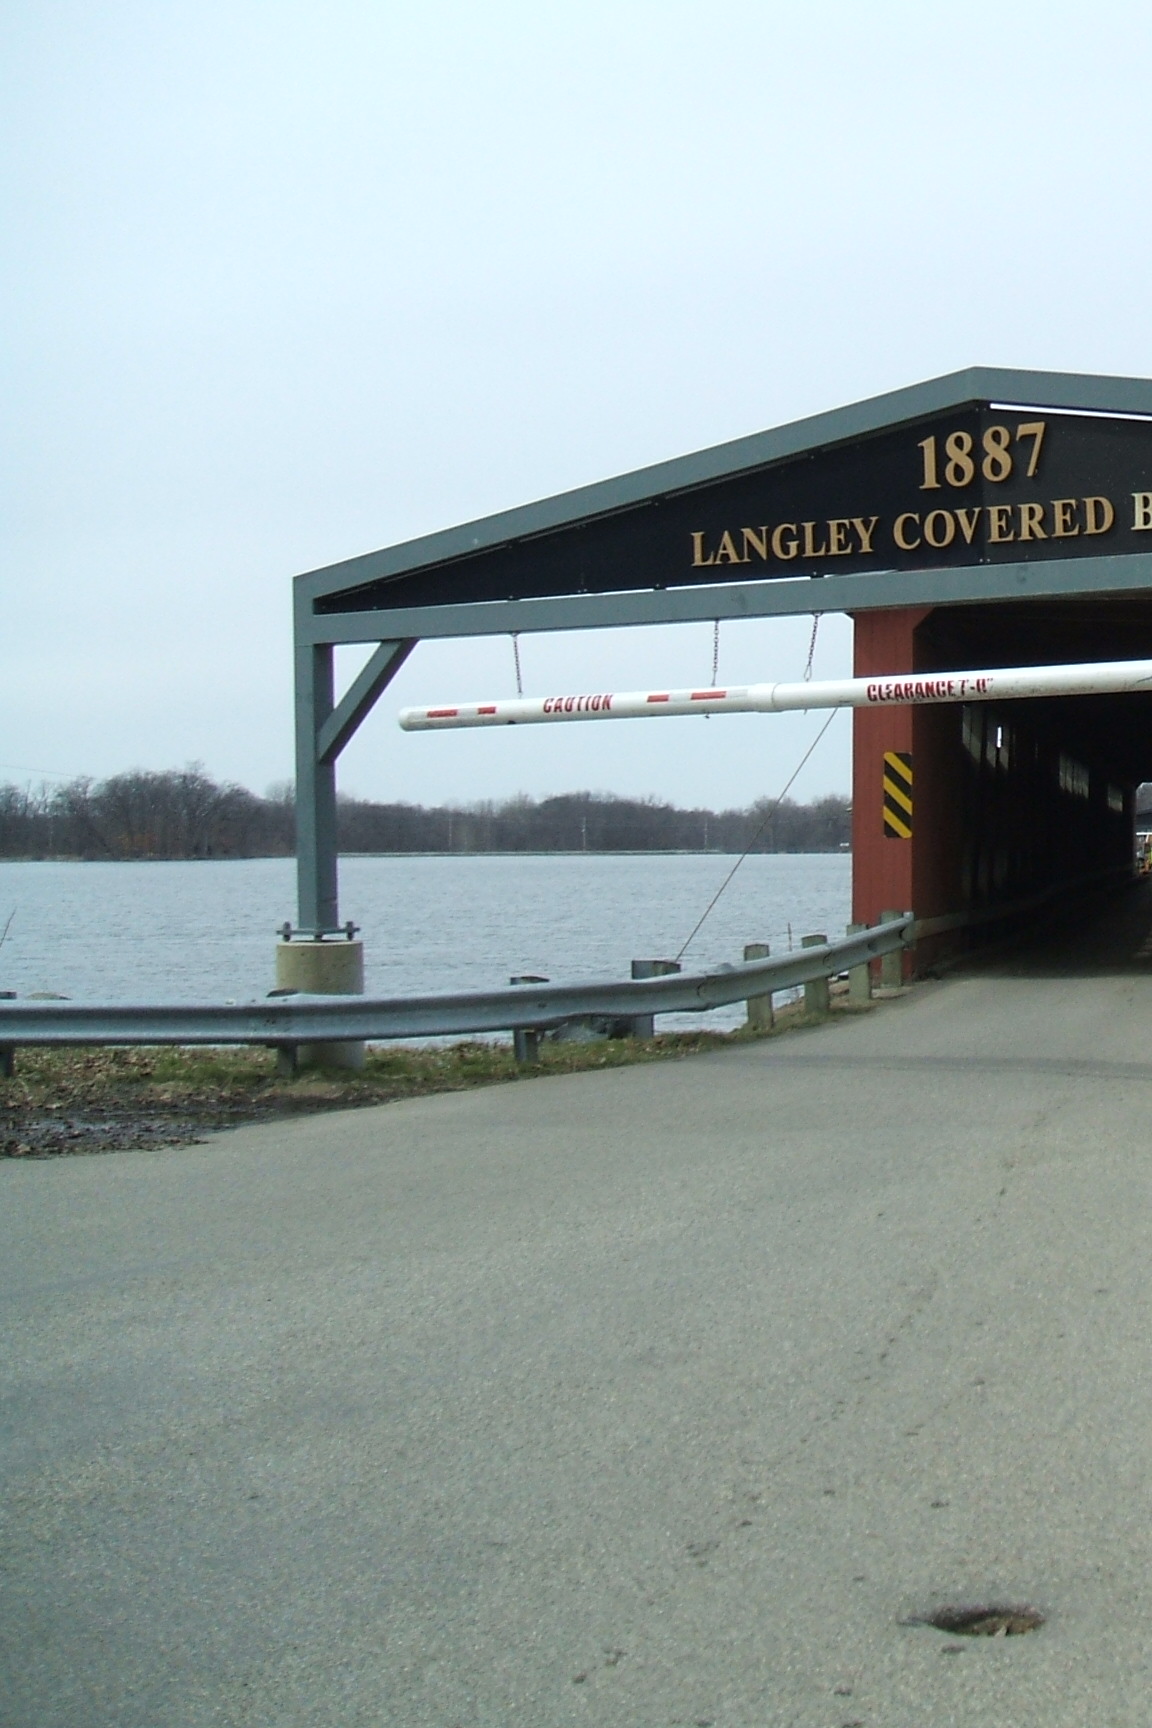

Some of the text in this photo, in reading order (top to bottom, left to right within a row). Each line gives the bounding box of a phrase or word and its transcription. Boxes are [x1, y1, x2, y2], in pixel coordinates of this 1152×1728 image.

[916, 421, 1046, 490] 1887
[690, 516, 879, 567] LANGLEY
[893, 497, 1115, 551] COVERED
[543, 694, 613, 713] CAUTION
[867, 680, 956, 702] CLEARANCE
